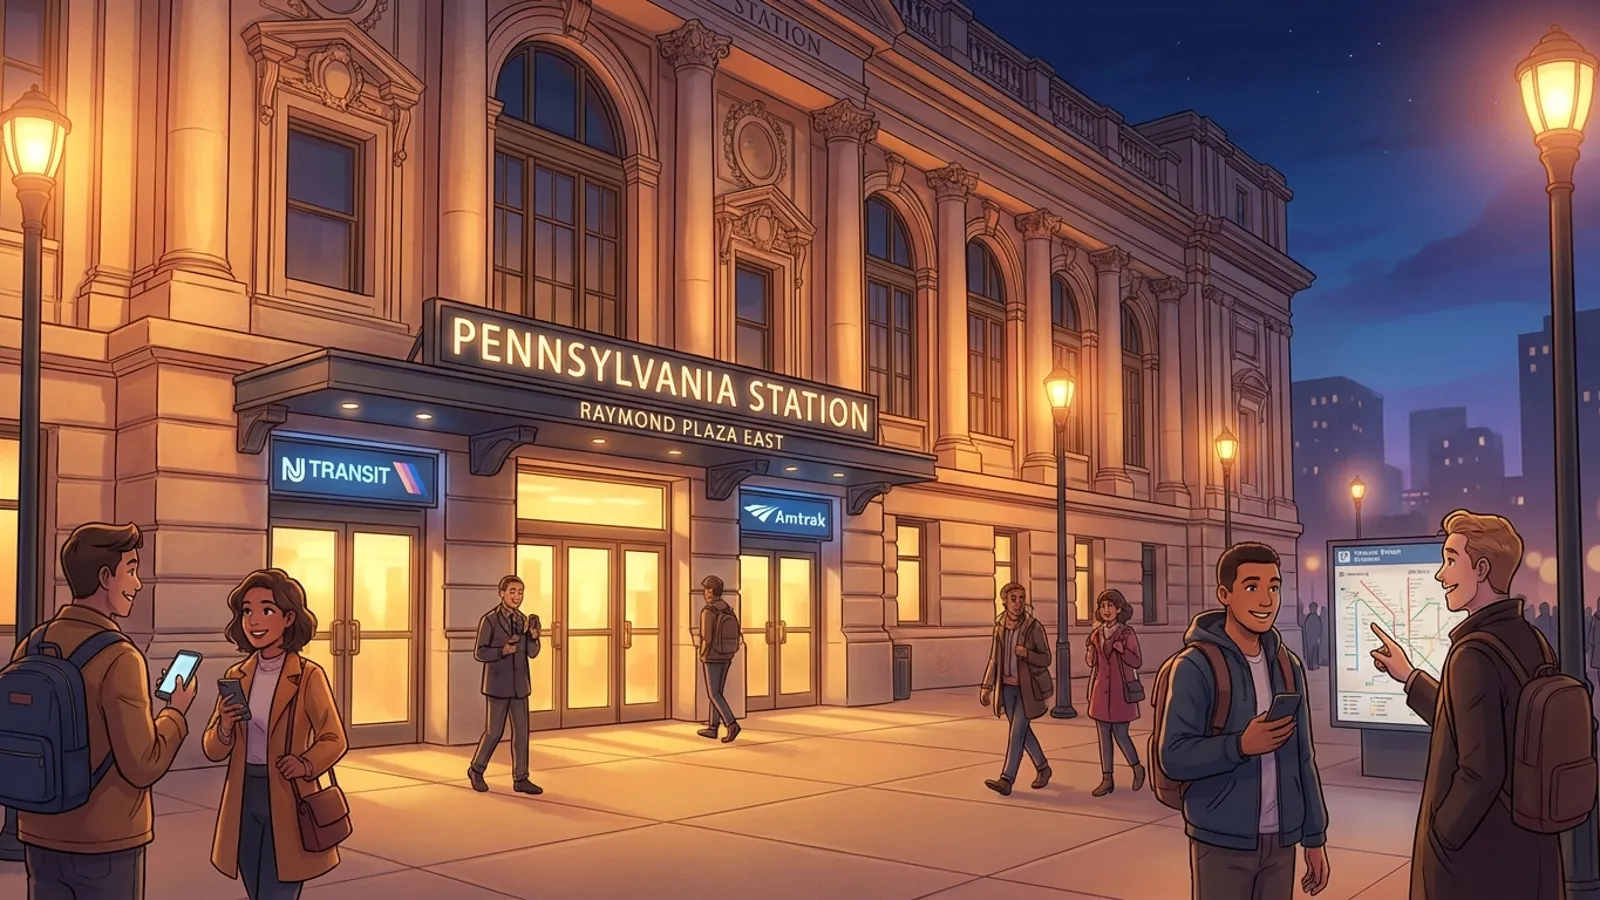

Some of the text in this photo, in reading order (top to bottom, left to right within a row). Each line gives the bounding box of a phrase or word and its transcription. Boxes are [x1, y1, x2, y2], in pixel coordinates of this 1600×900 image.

[734, 0, 822, 57] STATION
[452, 316, 871, 433] PENNSYLVANIA STATION
[579, 401, 785, 450] RAYMOND PLAZA EAST
[281, 456, 391, 485] NJ TRANSIT
[775, 510, 826, 528] Amtrak
